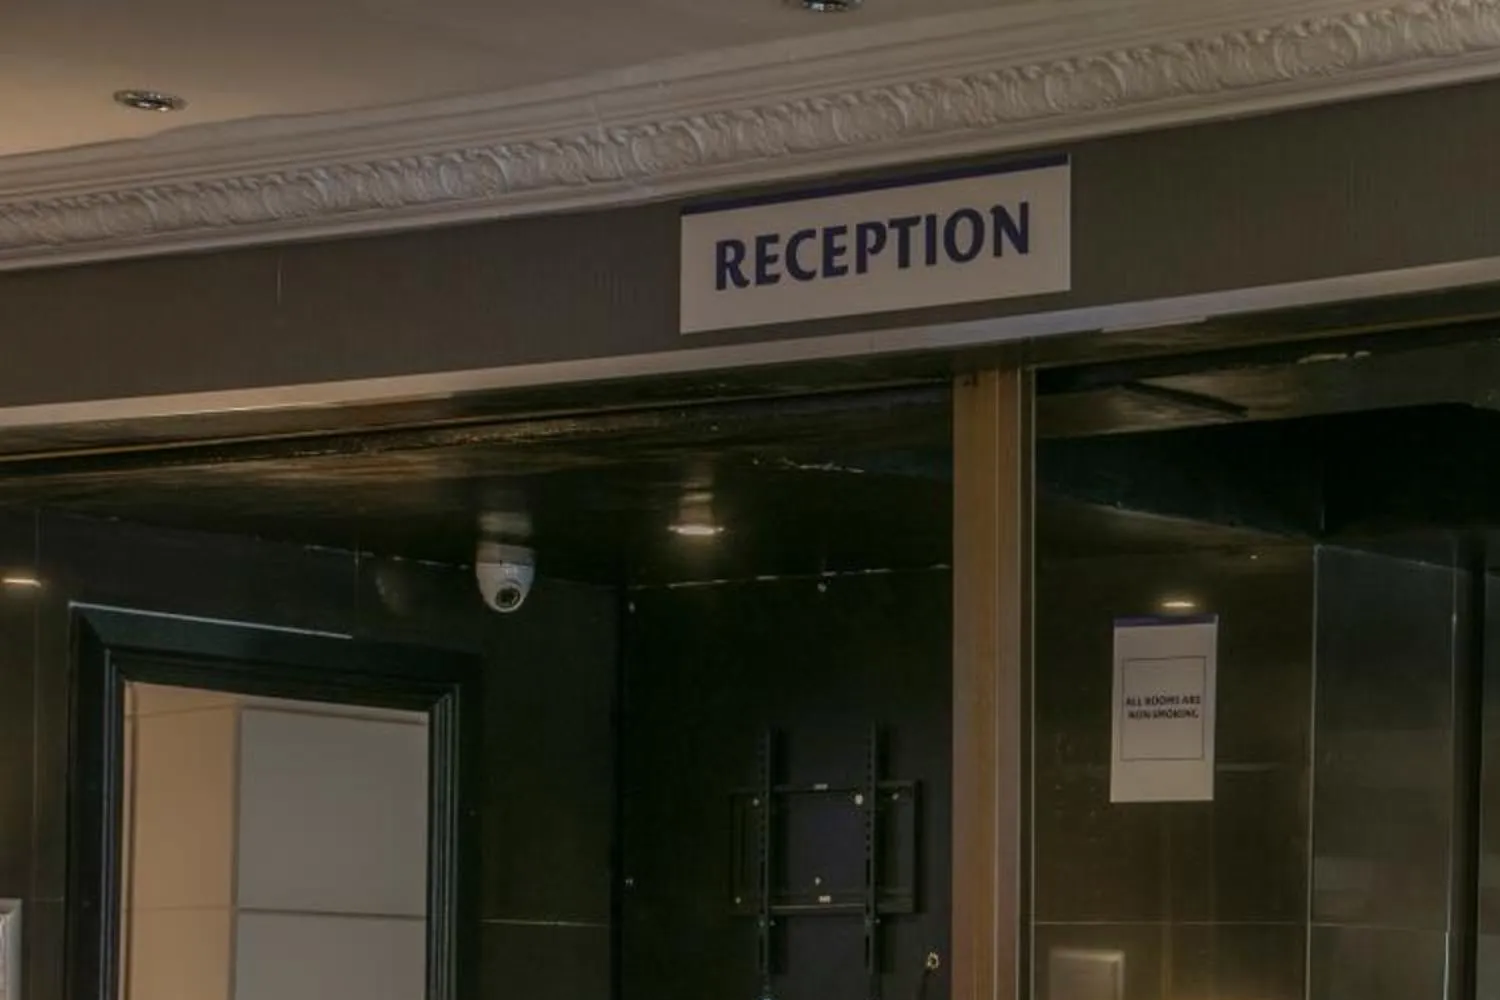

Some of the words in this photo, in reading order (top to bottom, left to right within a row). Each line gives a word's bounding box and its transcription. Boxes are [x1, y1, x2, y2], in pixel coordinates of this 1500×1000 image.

[715, 202, 1029, 290] RECEPTION
[1126, 696, 1141, 706] ALL
[1145, 695, 1179, 705] ROOMS
[1182, 695, 1201, 704] ARE
